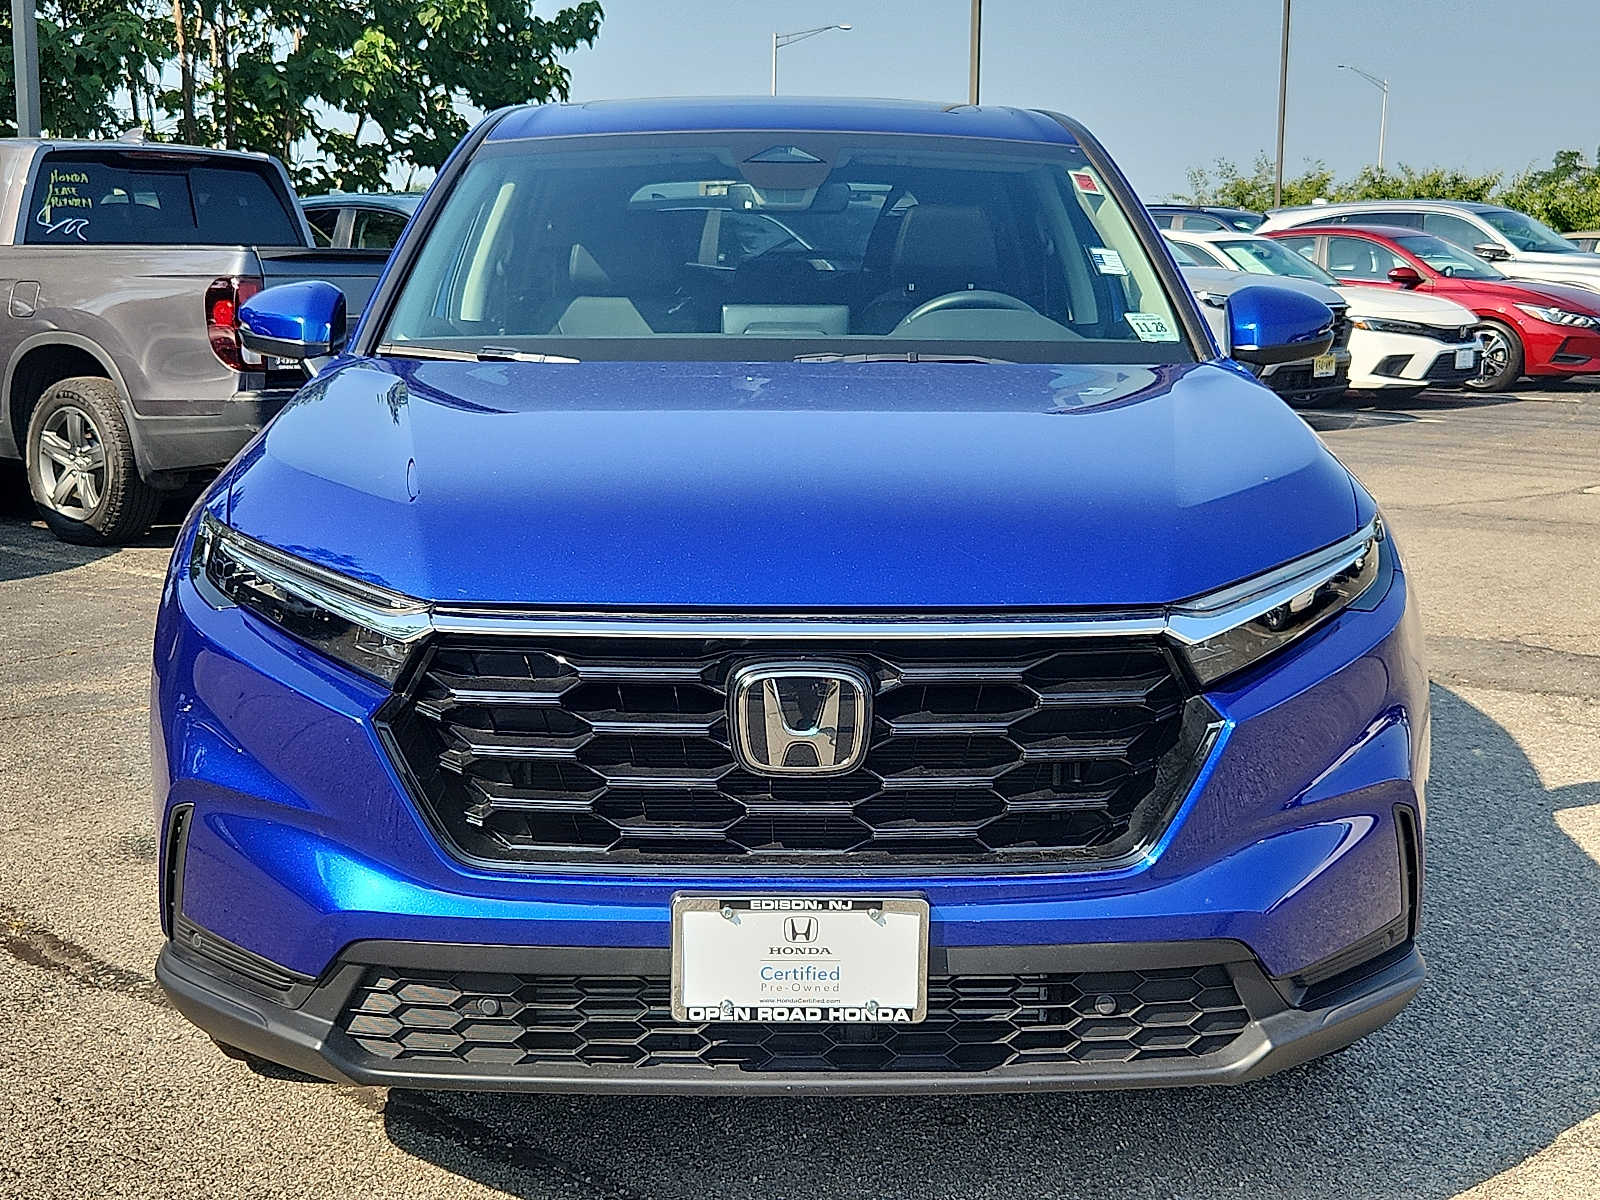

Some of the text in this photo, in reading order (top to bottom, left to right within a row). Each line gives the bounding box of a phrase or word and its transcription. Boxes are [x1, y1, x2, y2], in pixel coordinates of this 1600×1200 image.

[1135, 322, 1152, 333] 11
[749, 900, 853, 911] EDISON, NJ
[768, 946, 832, 955] HONDA
[760, 965, 841, 981] Certified
[760, 982, 840, 992] Pre-Owned
[688, 1007, 911, 1021] OPEN ROAD HONDA
